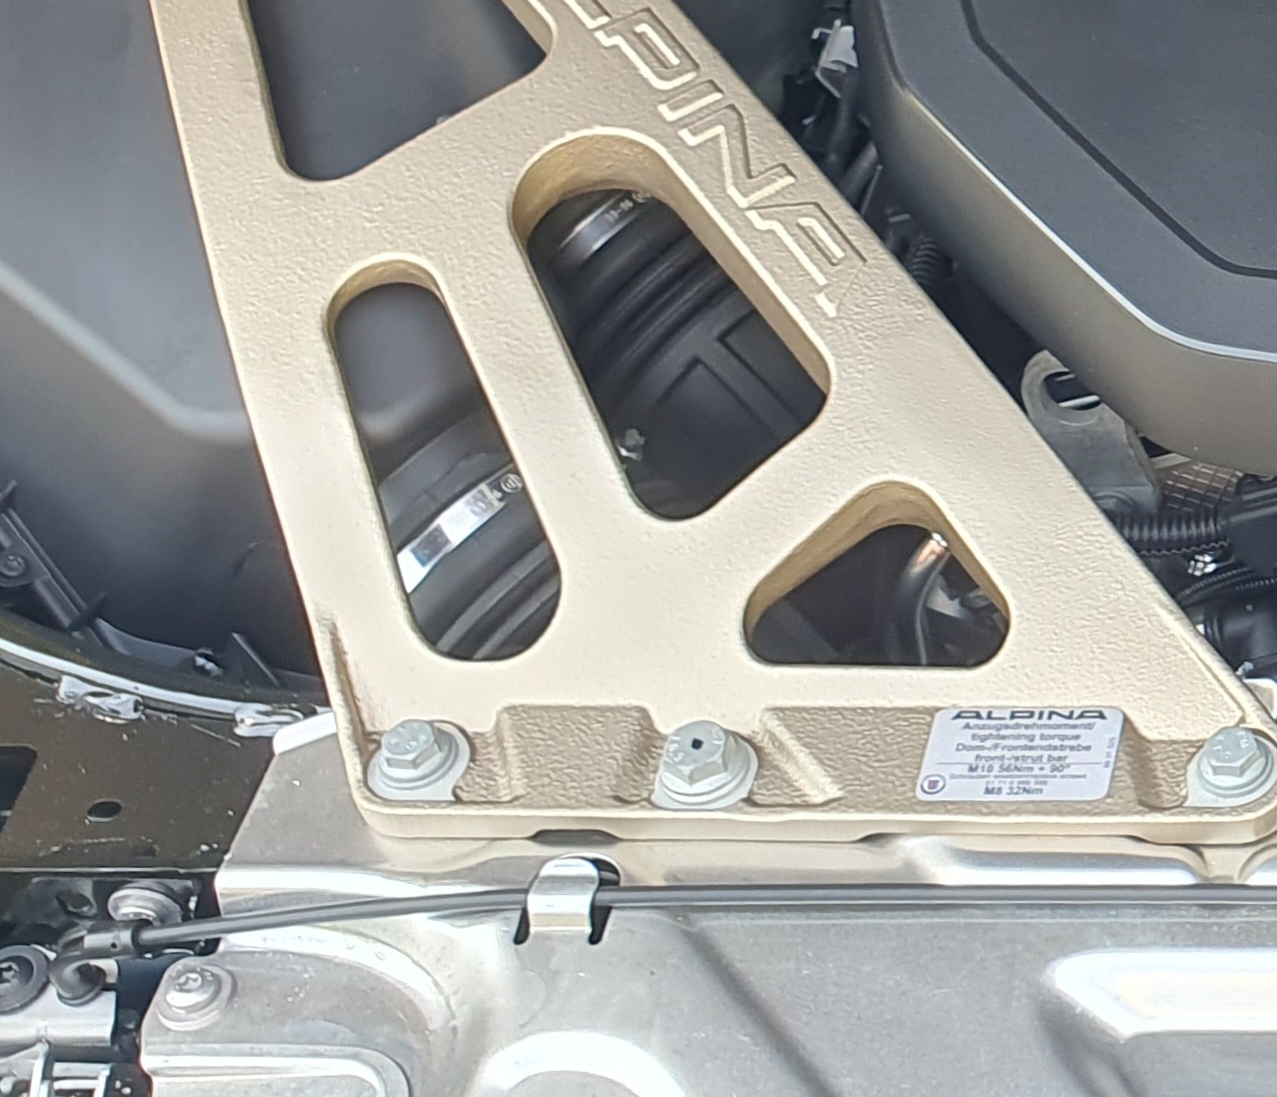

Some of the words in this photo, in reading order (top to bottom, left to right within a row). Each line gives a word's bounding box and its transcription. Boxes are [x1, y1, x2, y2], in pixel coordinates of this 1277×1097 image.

[951, 709, 1108, 720] ALPINA
[971, 731, 1037, 743] tightening
[1040, 732, 1081, 743] torque
[1047, 753, 1069, 763] bar
[1006, 786, 1043, 795] 32Nm
